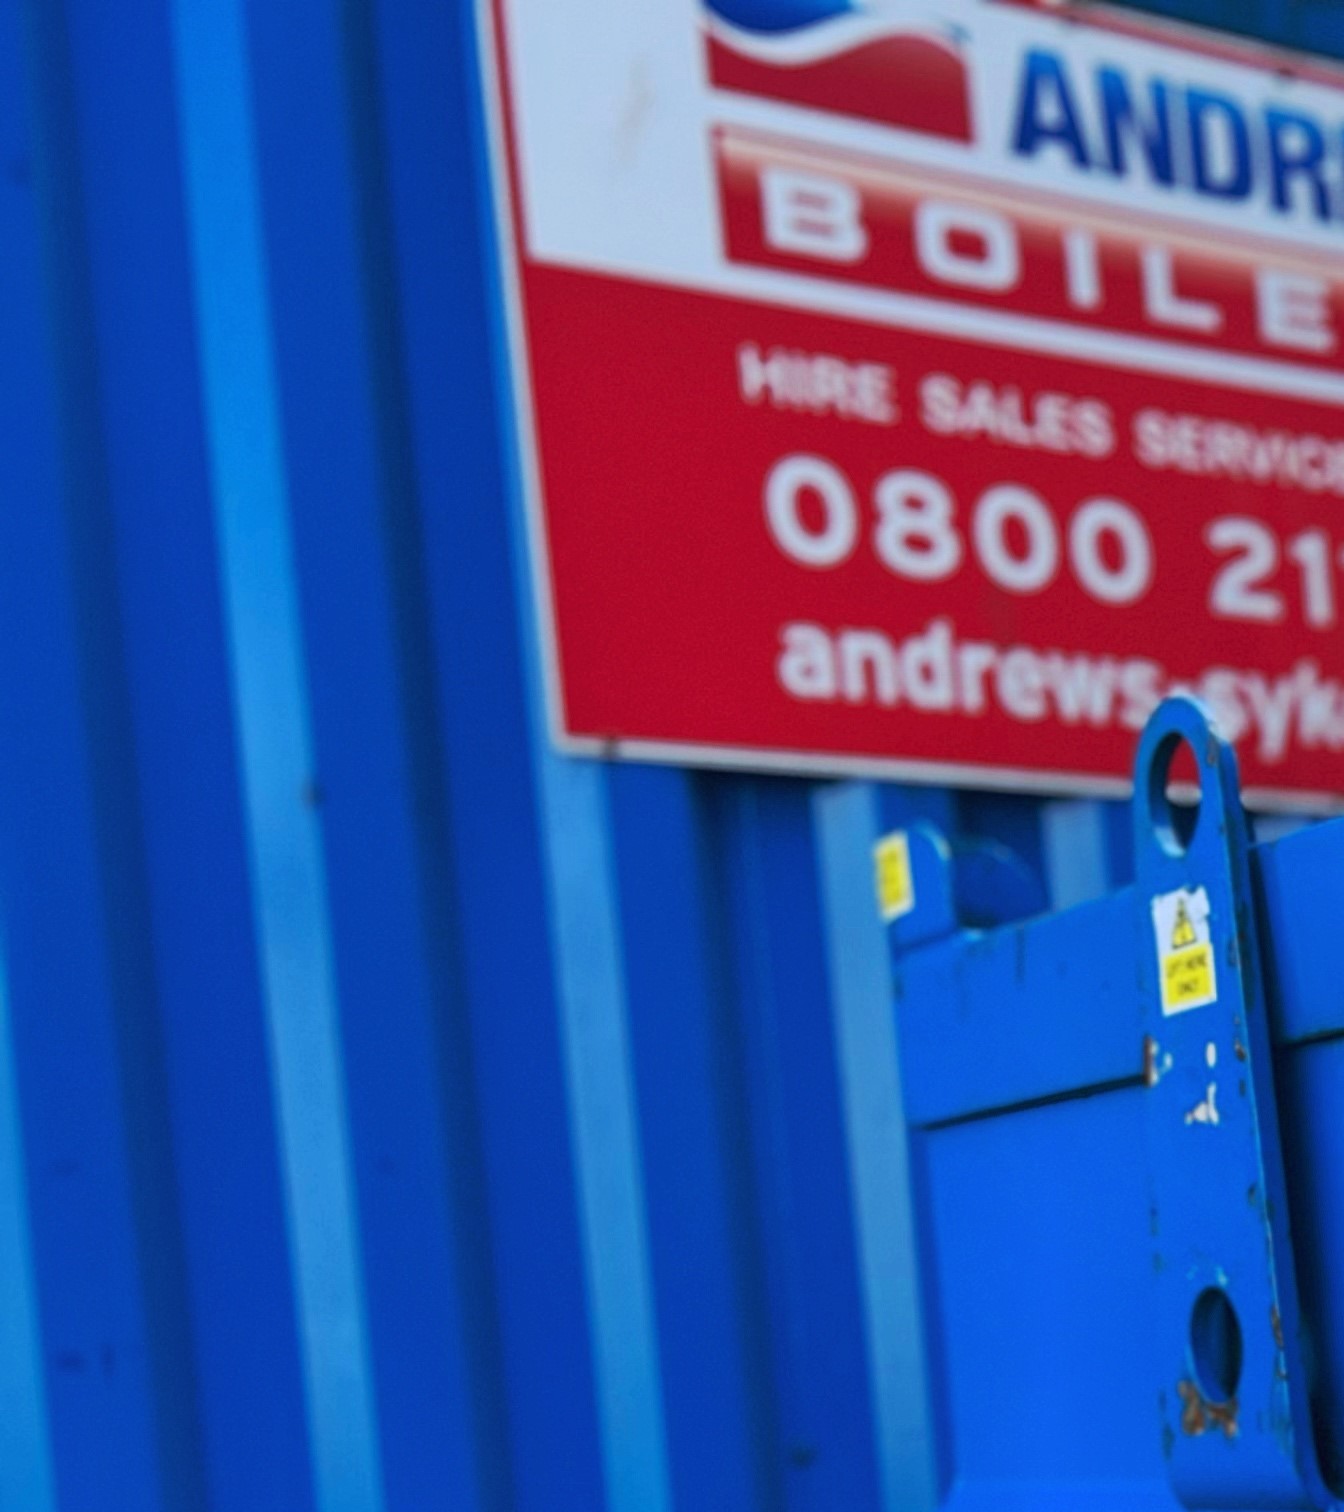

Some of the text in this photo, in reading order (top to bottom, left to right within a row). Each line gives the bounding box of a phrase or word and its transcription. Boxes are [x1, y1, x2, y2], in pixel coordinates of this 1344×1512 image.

[739, 343, 896, 426] HIRE
[919, 374, 1114, 459] SALES
[763, 453, 1154, 604] 0800
